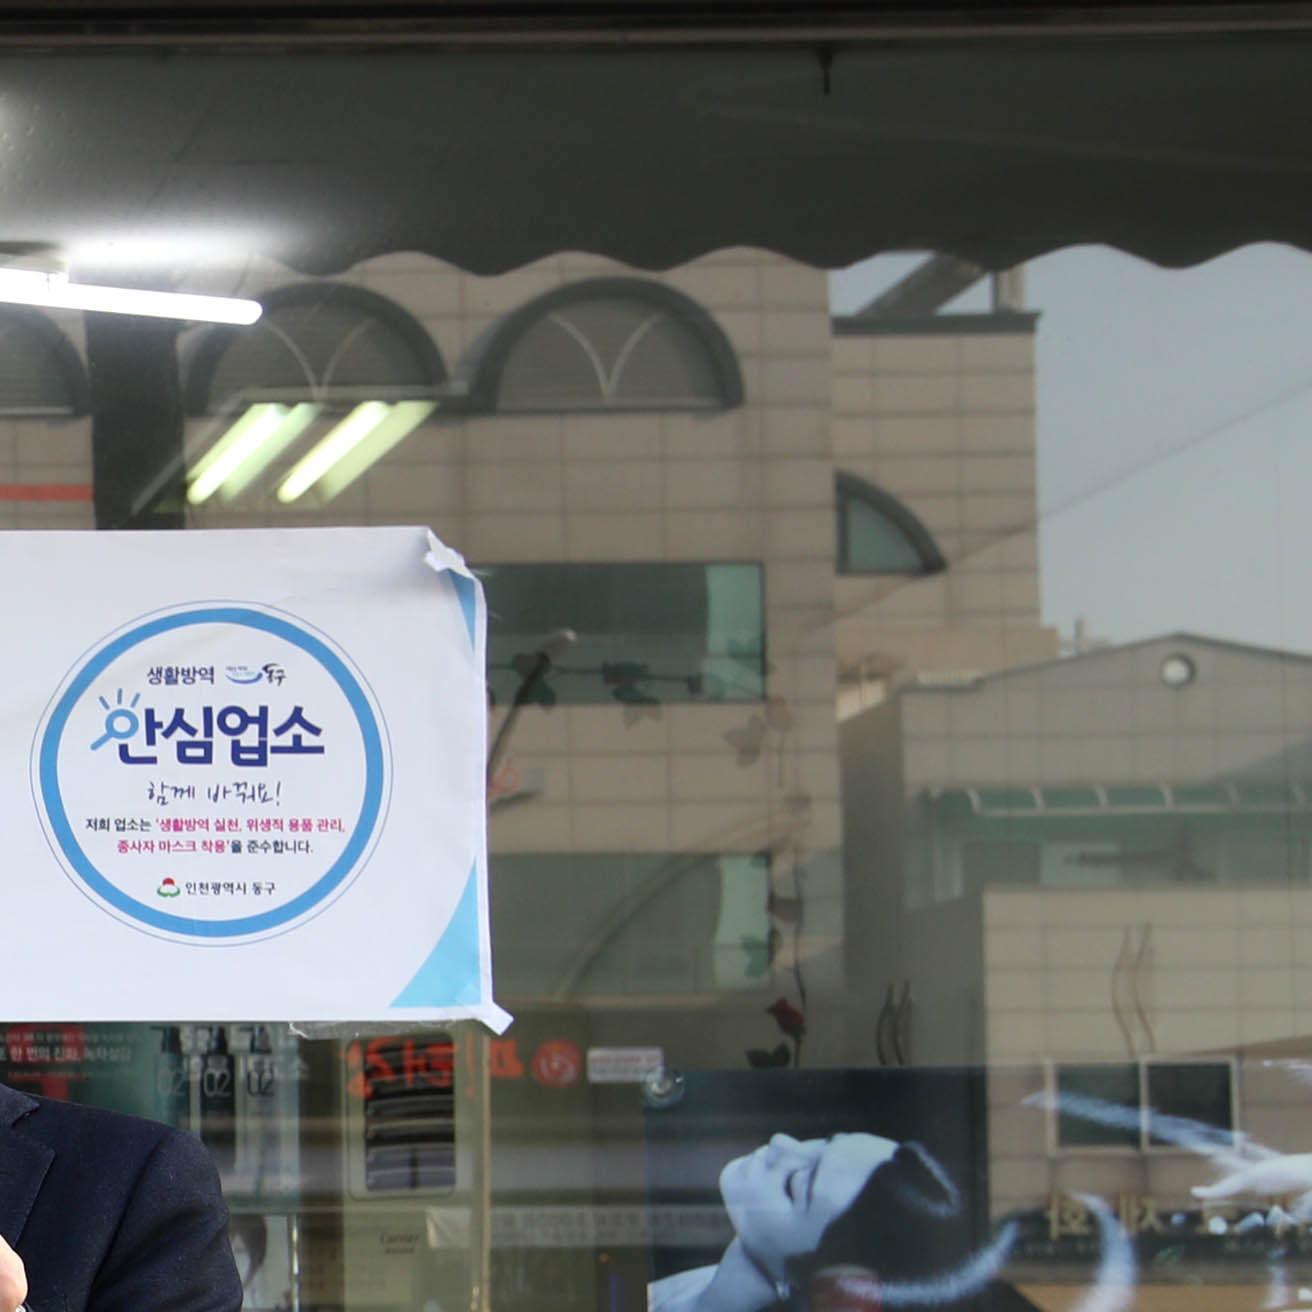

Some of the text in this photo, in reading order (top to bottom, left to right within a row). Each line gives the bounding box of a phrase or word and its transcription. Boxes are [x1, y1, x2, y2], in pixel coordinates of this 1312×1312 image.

[146, 665, 215, 686] 생활방역
[91, 704, 326, 768] 안심업소
[146, 780, 282, 807] 함께 바꿔요!
[85, 816, 111, 834] 저희
[113, 816, 152, 834] 업소는
[246, 816, 284, 834] 위생적
[288, 816, 313, 834] 용품
[117, 839, 155, 855] 종사자
[158, 839, 197, 855] 마스크
[246, 839, 315, 855] 준수합니다.
[184, 881, 277, 897] 인천광역시 동구
[203, 1071, 232, 1098] 02
